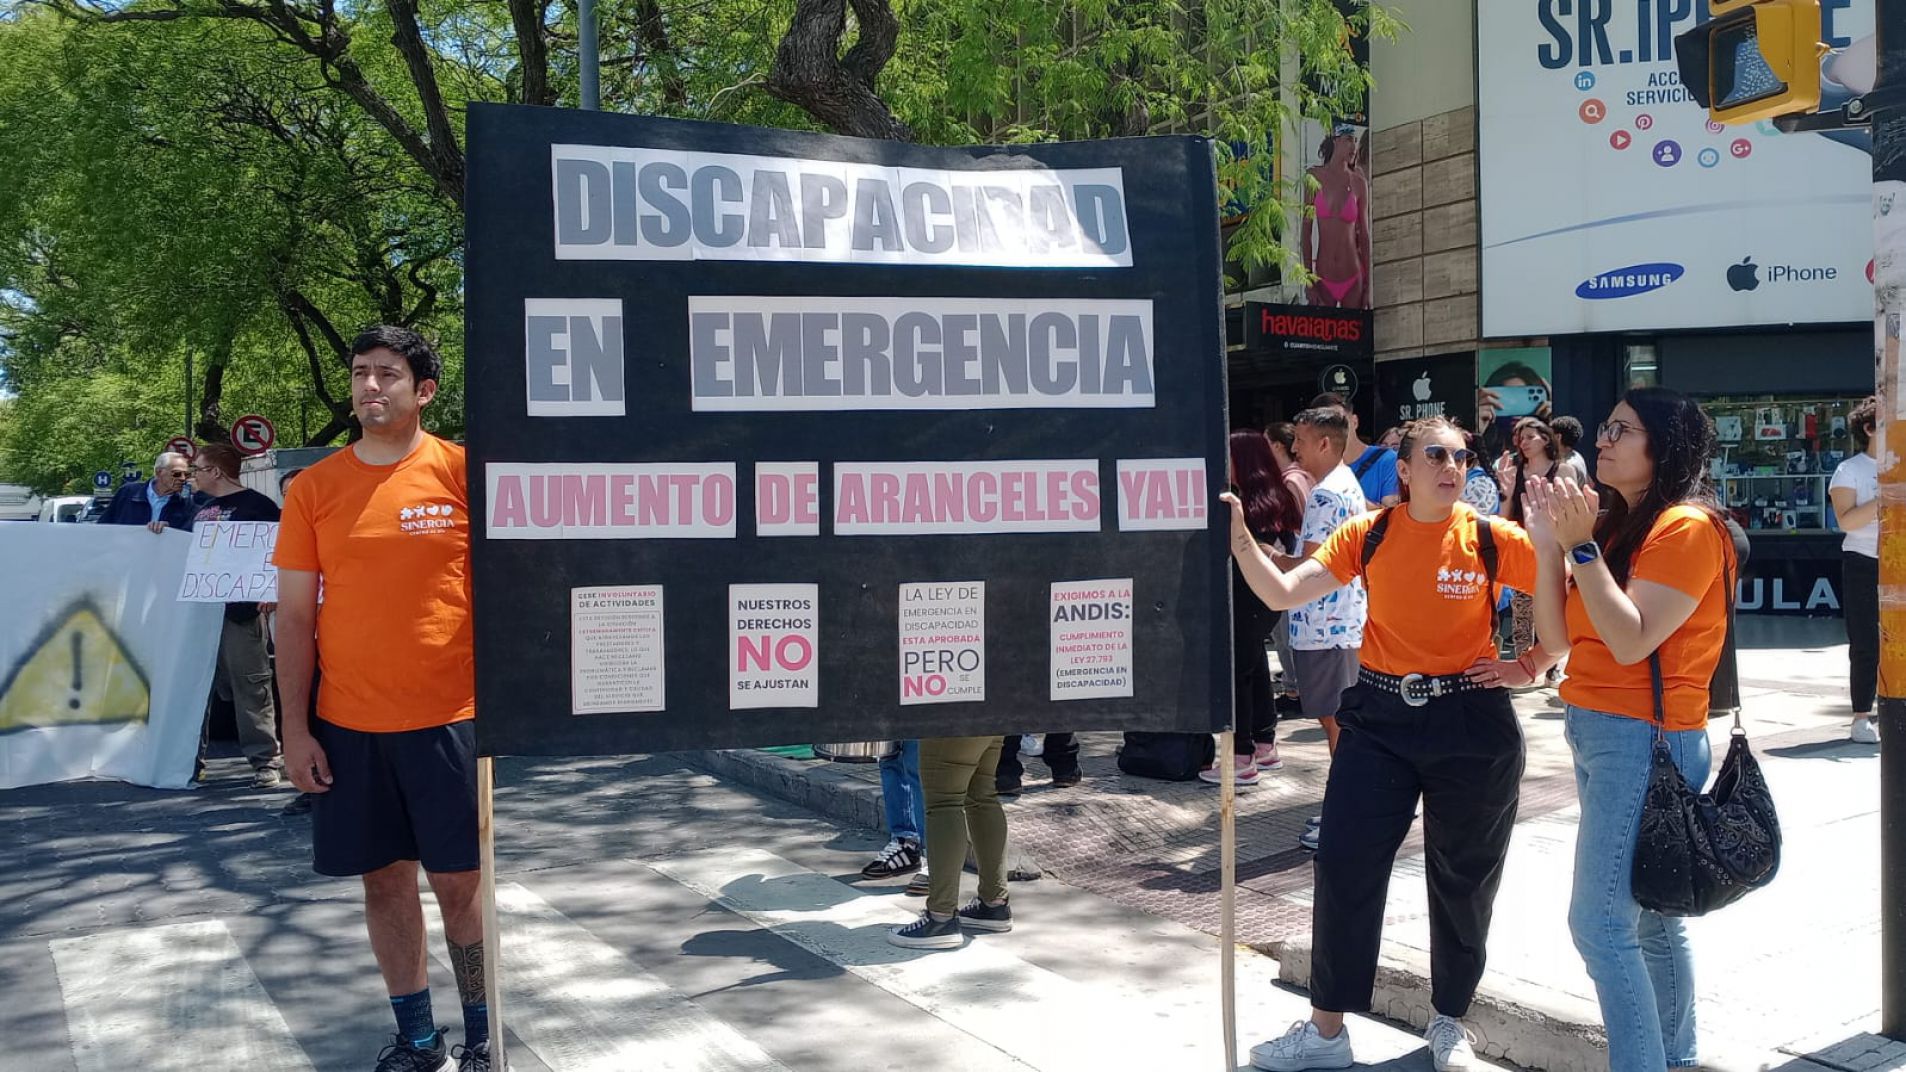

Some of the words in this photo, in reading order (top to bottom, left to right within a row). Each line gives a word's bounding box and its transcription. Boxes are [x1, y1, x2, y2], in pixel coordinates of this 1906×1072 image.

[1648, 71, 1682, 87] ACC
[556, 159, 1127, 256] DISCAPACIDAD
[1588, 272, 1673, 290] SAMSUNG
[1768, 265, 1838, 283] iPhone
[1261, 308, 1361, 341] havaianas
[527, 315, 624, 402] EN
[692, 311, 1153, 398] EMERGENCIA
[1399, 404, 1414, 421] SR.
[1416, 401, 1446, 420] PHONE
[492, 473, 735, 528] AUMENTO
[759, 473, 818, 525] DE
[836, 470, 1100, 524] ARANCELES
[1119, 469, 1205, 520] YA!!
[905, 587, 923, 602] LA
[928, 587, 954, 601] LEY
[958, 586, 978, 601] DE
[1053, 590, 1106, 601] EXIGIMOS
[1107, 589, 1116, 599] A
[1118, 589, 1131, 599] LA
[1734, 577, 1840, 610] ULA
[578, 600, 592, 609] DE
[593, 599, 656, 608] ACTIVIDADES
[737, 599, 811, 611] NUESTROS
[903, 607, 963, 618] EMERGENCIA
[964, 606, 977, 616] EN
[1053, 602, 1131, 623] ANDIS:
[737, 618, 812, 630] DERECHOS
[904, 620, 979, 632] DISCAPACIDAD
[902, 636, 926, 646] ESTA
[927, 634, 981, 645] APROBADA
[1059, 631, 1125, 642] CUMPLIMIENTO
[737, 634, 813, 673] NO
[1055, 643, 1104, 654] INMEDIATO
[904, 648, 980, 675] PERO
[958, 674, 971, 683] SE
[1055, 667, 1115, 679] (EMERGENCIA
[737, 680, 751, 691] SE
[753, 679, 810, 690] AJUSTAN
[903, 674, 947, 698] NO
[946, 685, 983, 696] CUMPLE
[1056, 676, 1128, 690] DISCAPACIDAD)
